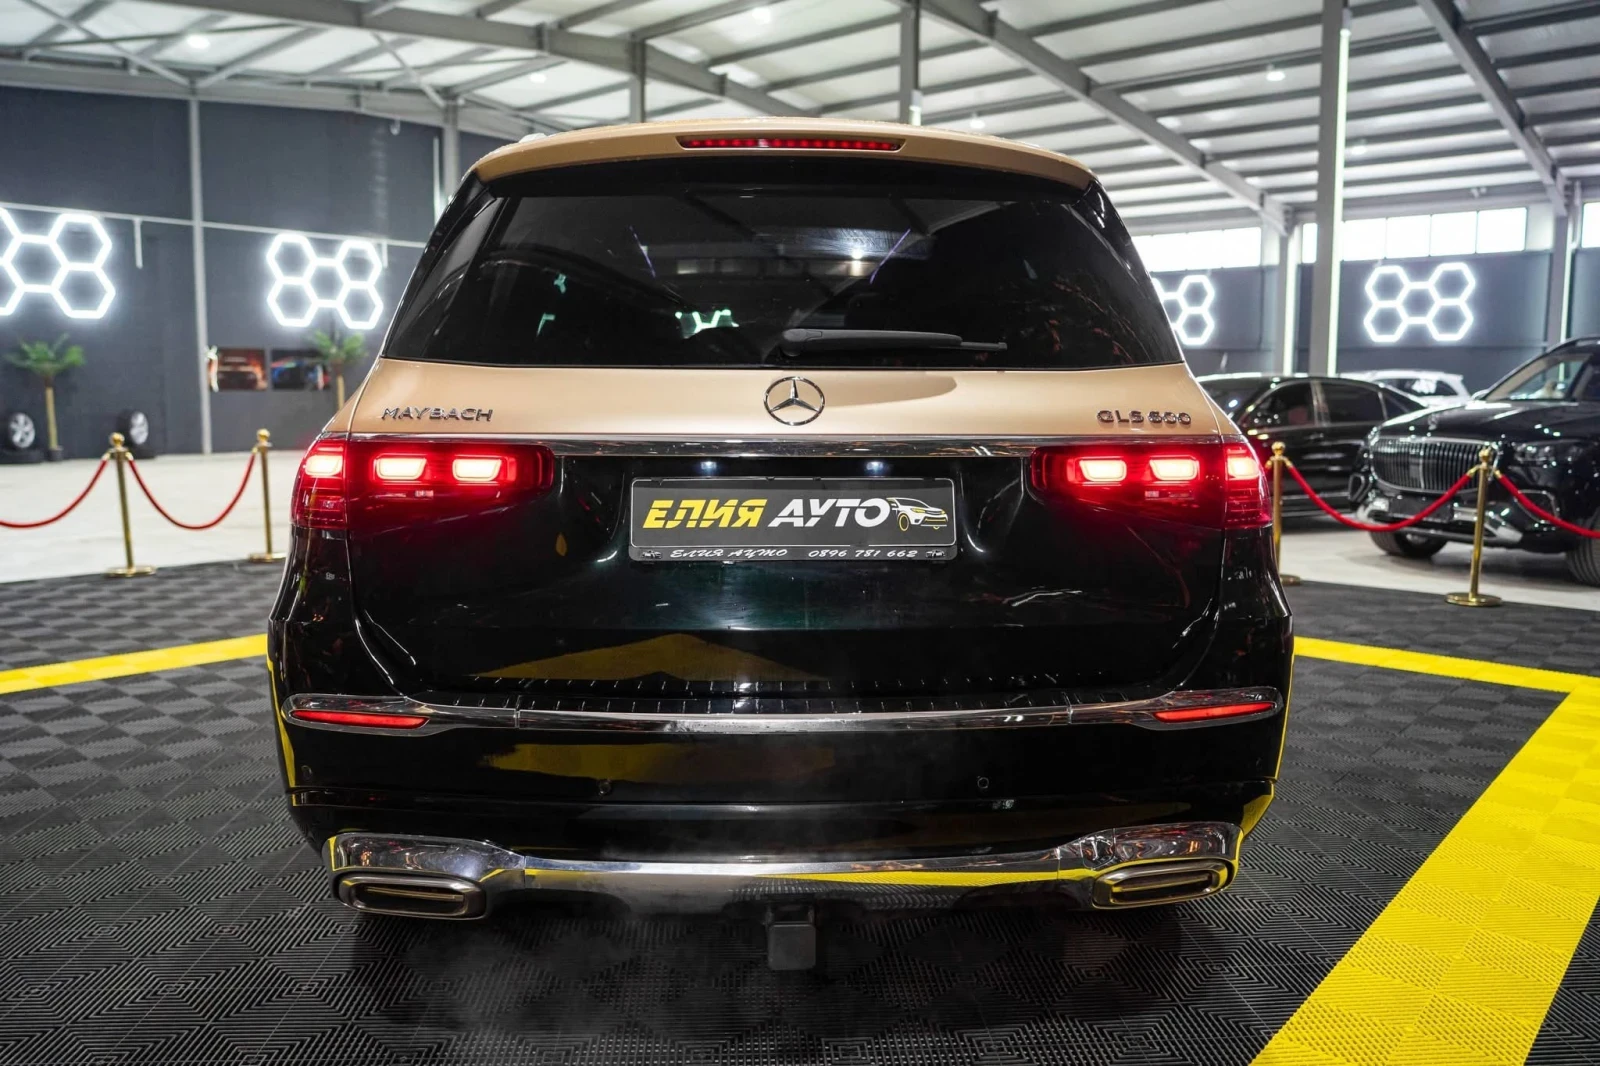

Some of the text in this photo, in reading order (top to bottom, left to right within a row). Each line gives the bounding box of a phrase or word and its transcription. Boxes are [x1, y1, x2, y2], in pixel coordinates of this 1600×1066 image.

[381, 406, 494, 422] MAYBACH
[1097, 409, 1145, 424] GLS
[642, 498, 890, 528] ЕЛИЯ АУТО
[808, 549, 848, 558] 0896
[854, 549, 881, 558] 781
